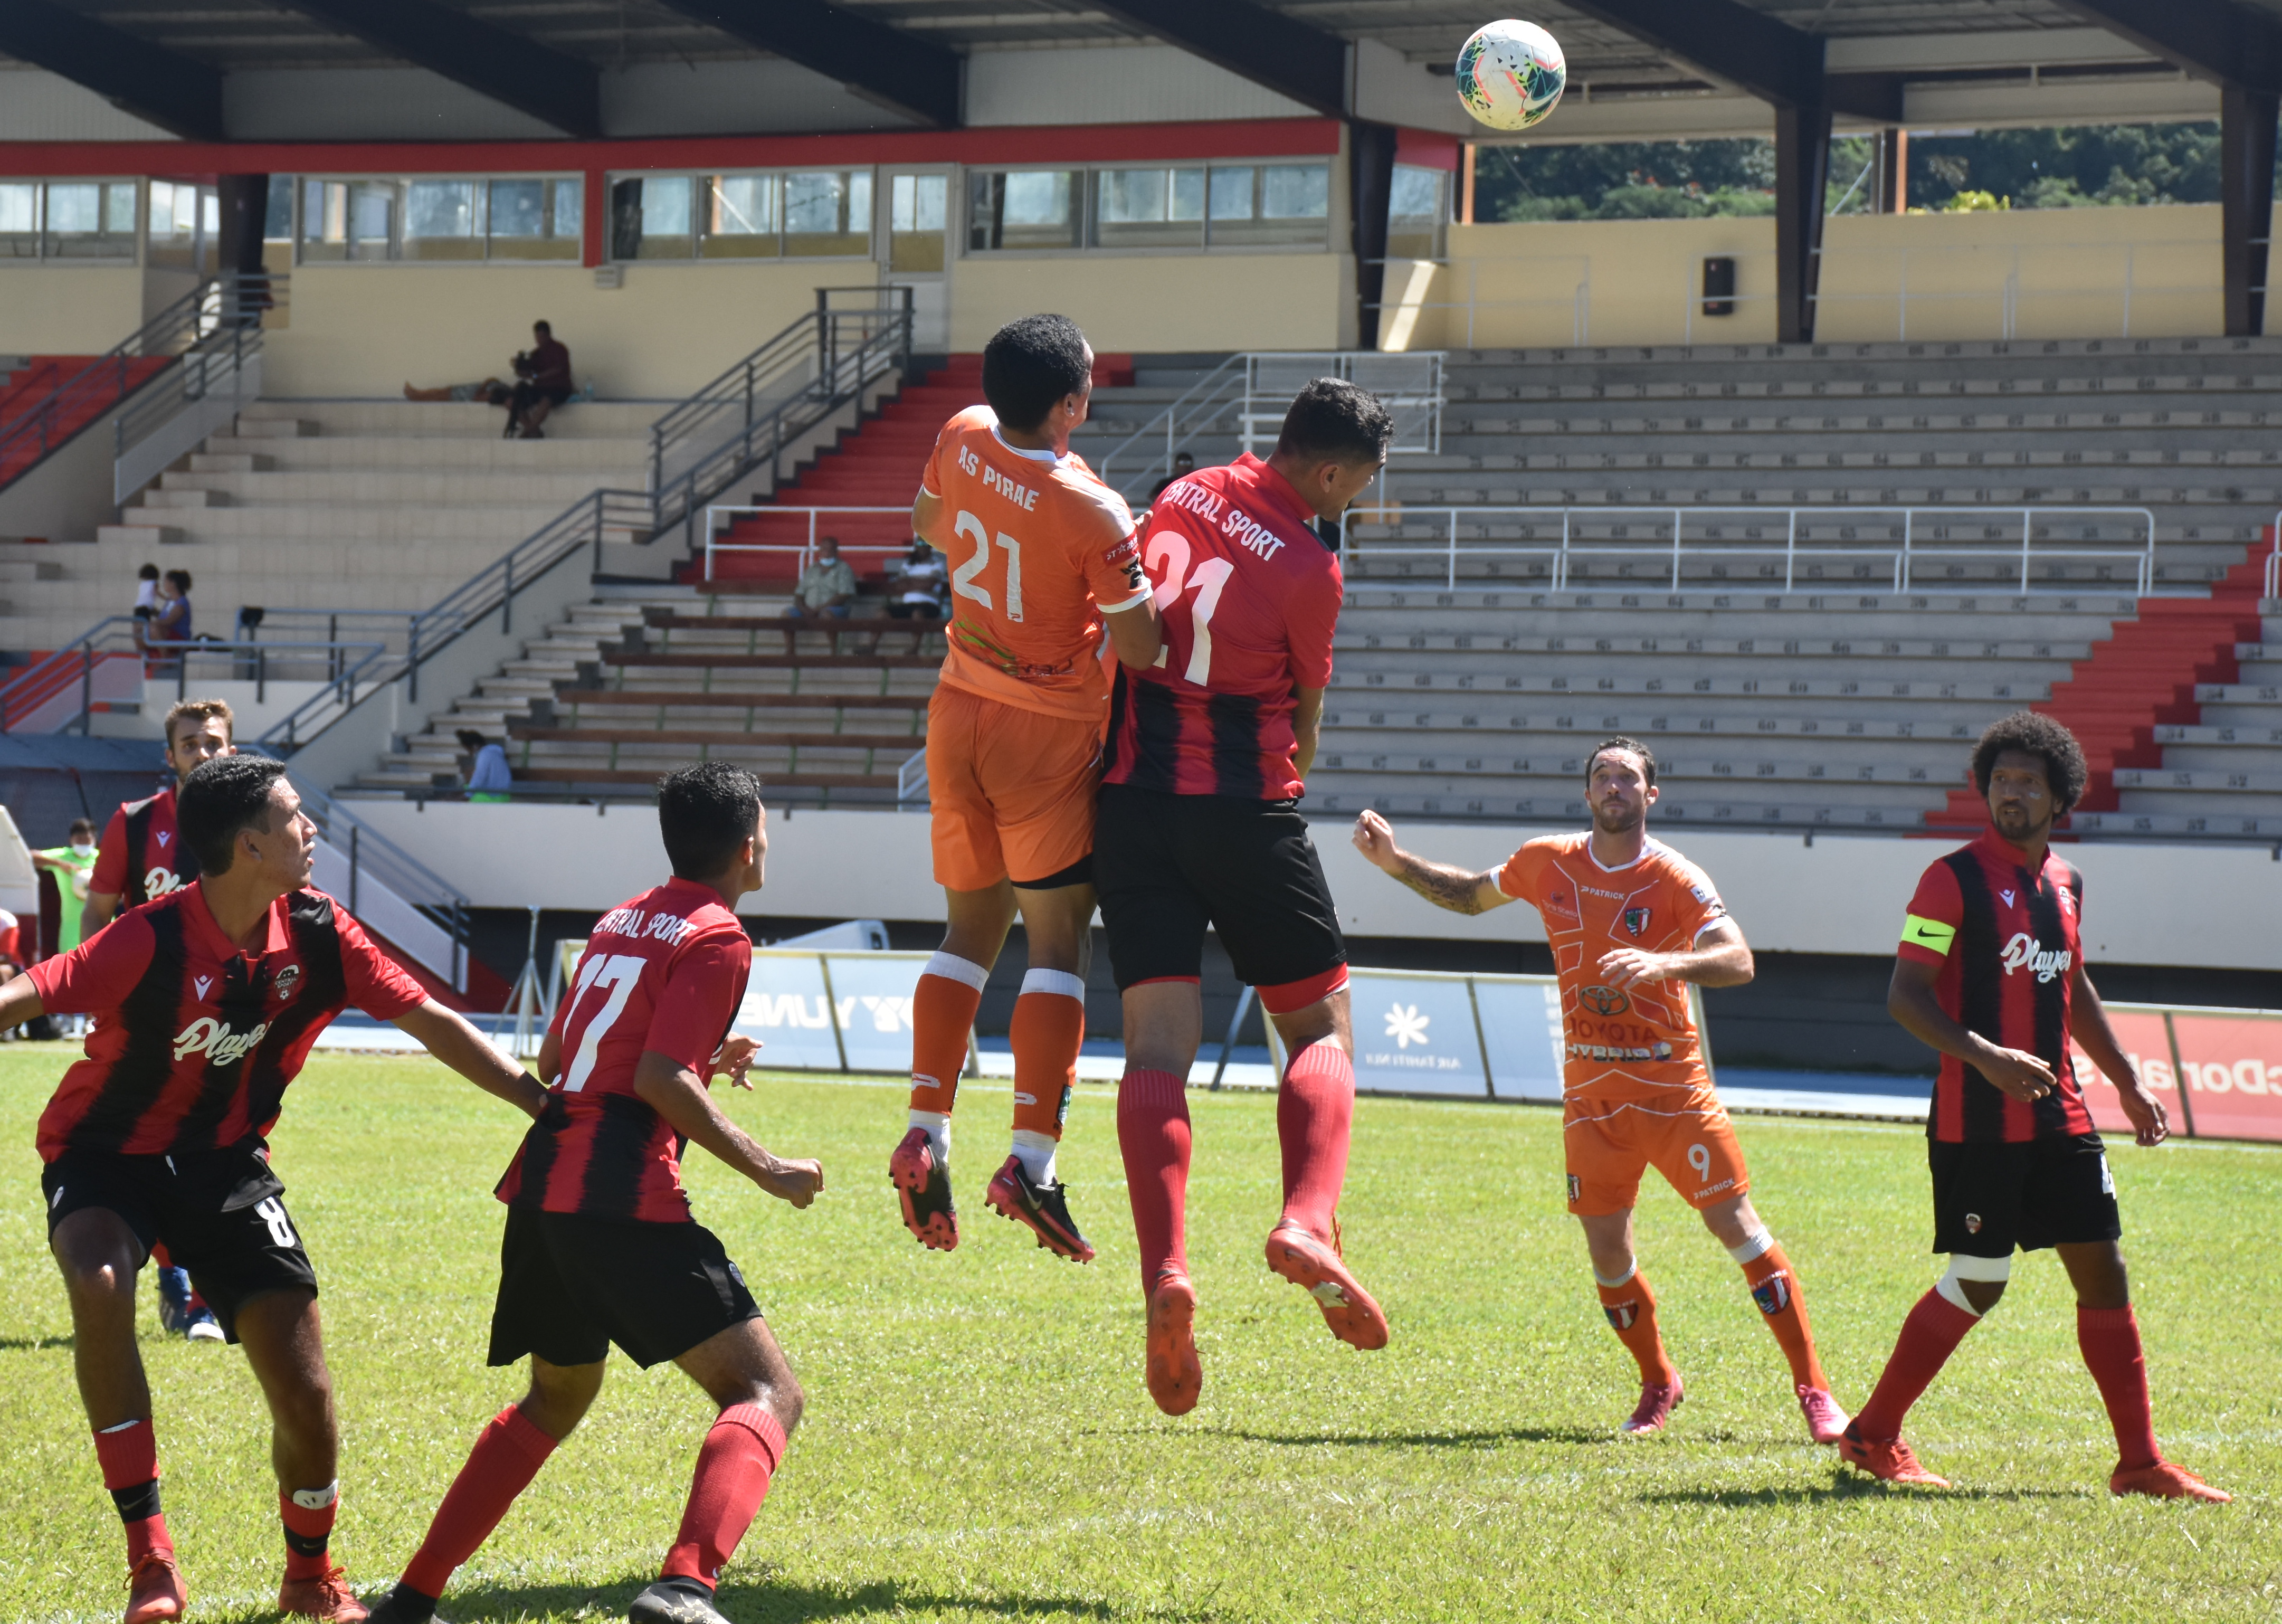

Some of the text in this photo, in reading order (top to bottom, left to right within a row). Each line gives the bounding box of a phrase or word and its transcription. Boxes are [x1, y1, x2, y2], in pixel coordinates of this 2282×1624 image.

[957, 444, 1040, 512] AS PIRAE
[1162, 481, 1286, 562] CENTRAL SPORT
[953, 510, 1024, 623] 21
[1144, 530, 1234, 687] 21
[1590, 888, 1625, 900] PATRICK
[641, 913, 699, 946] SPORT
[563, 953, 648, 1092] 17
[1570, 1017, 1660, 1043] TOYOTA
[1688, 1143, 1710, 1182] 9
[1699, 1177, 1736, 1199] PATRICK
[254, 1195, 295, 1248] 8
